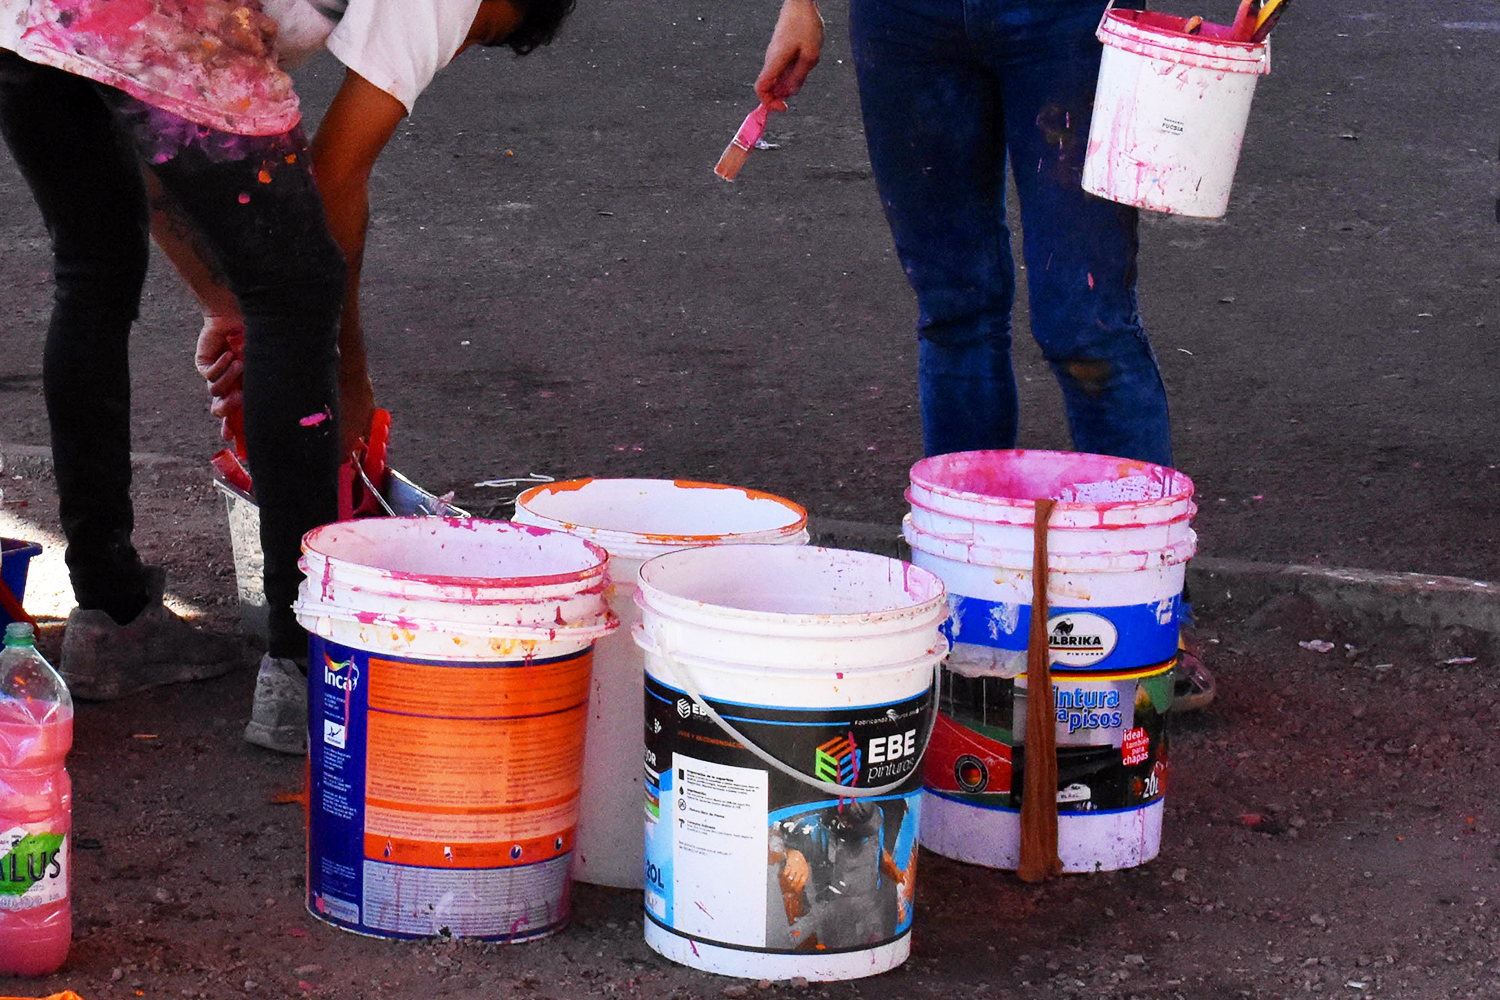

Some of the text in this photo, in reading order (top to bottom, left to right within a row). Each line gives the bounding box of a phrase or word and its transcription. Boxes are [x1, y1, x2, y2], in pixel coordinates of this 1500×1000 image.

[1161, 122, 1184, 132] FUCSIA
[324, 666, 353, 692] Inca
[1068, 708, 1122, 734] pisos
[1123, 726, 1144, 742] ideal
[868, 728, 916, 764] EBE
[1122, 751, 1149, 766] chapas
[867, 757, 915, 783] pinturas
[1143, 770, 1159, 798] 20L
